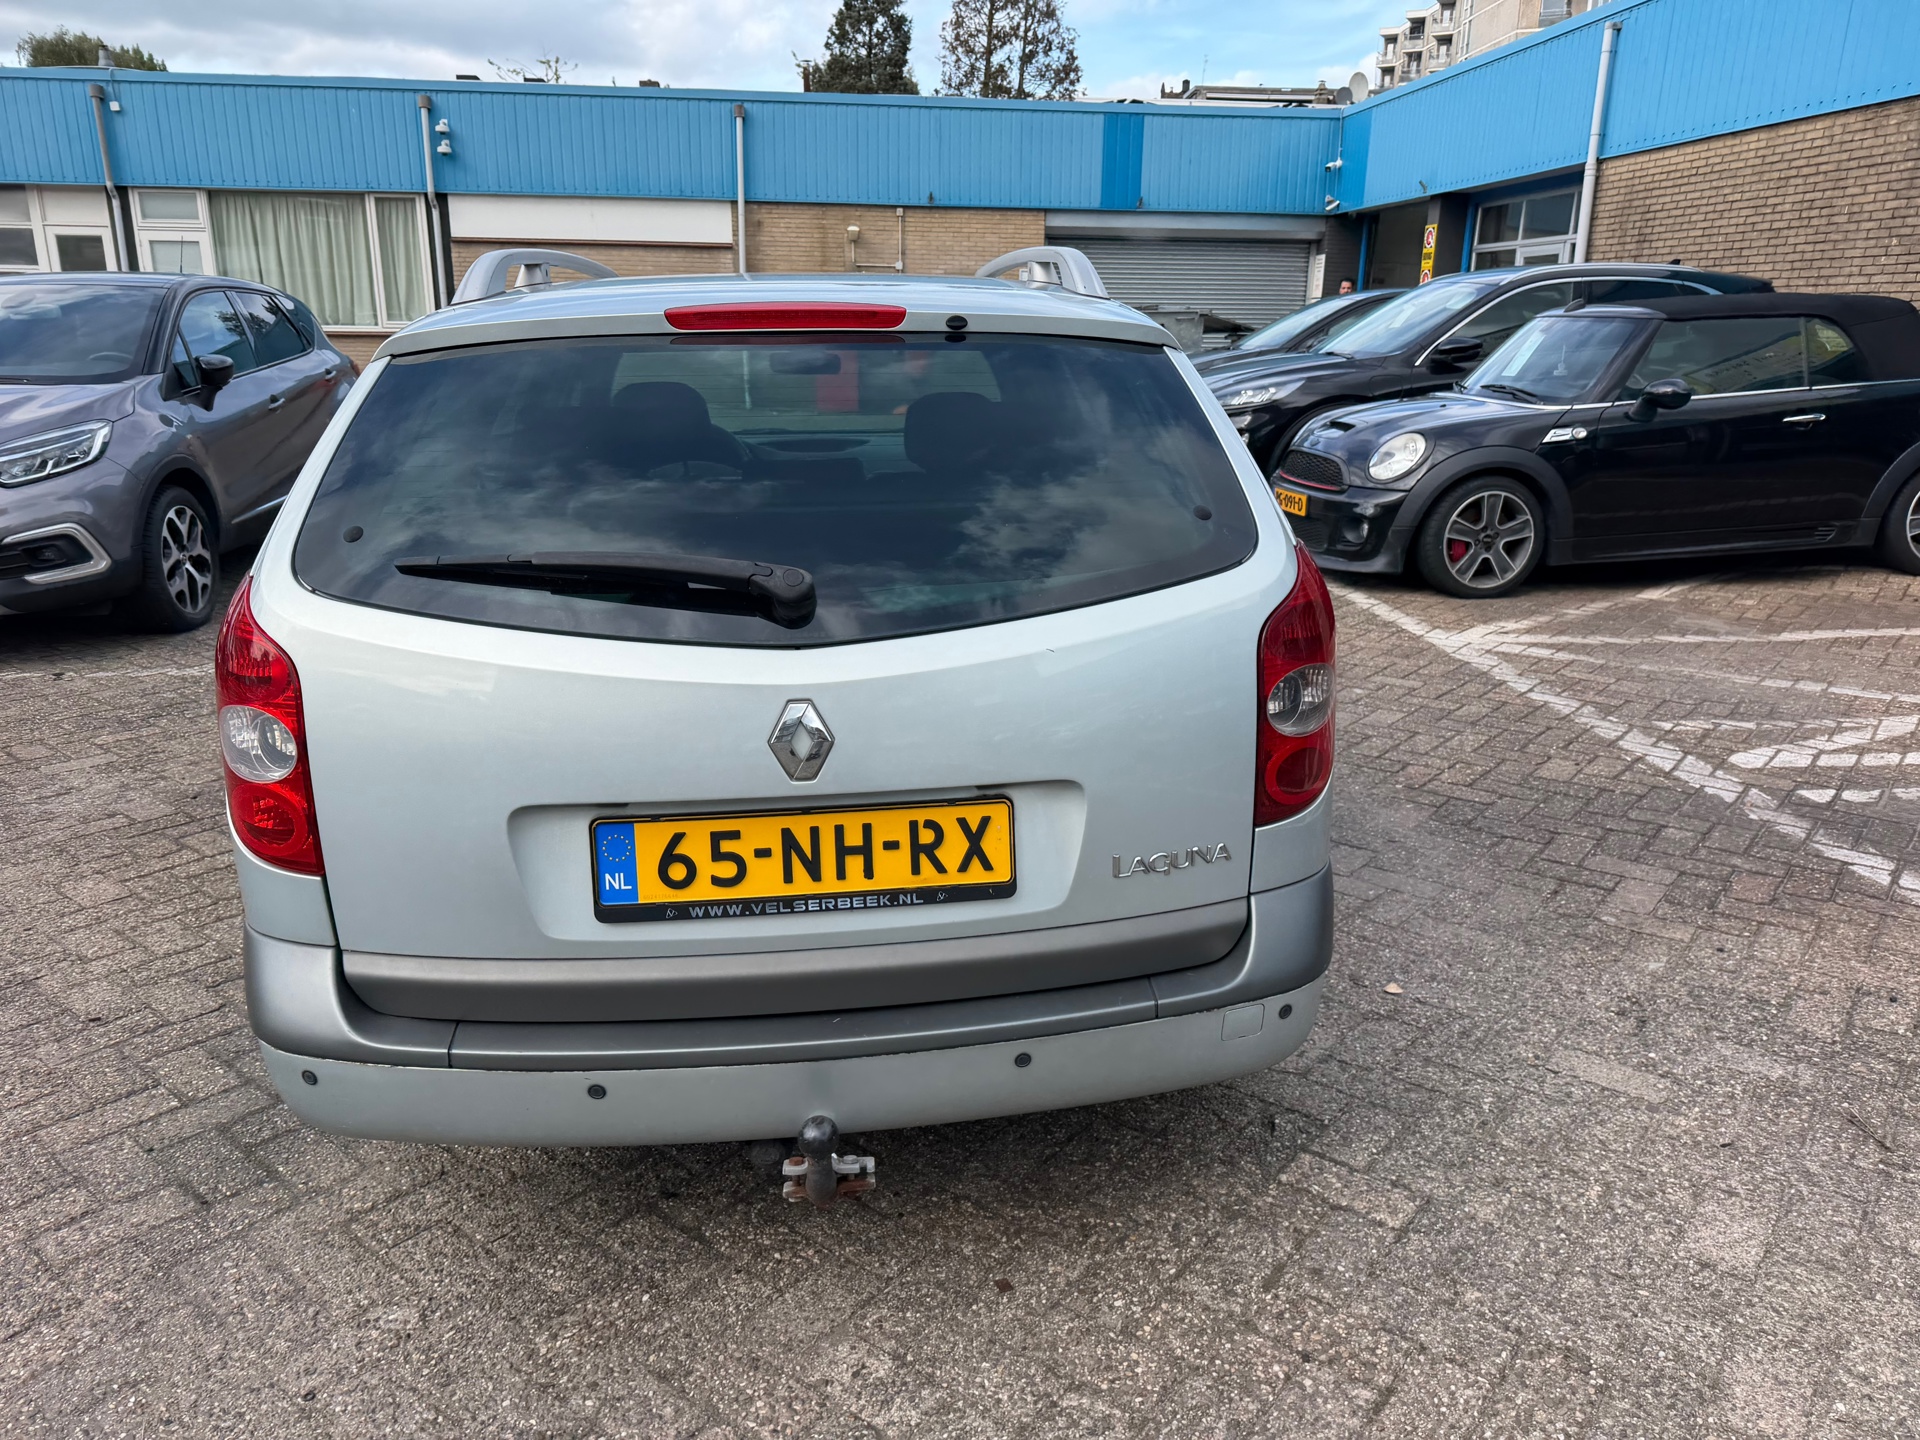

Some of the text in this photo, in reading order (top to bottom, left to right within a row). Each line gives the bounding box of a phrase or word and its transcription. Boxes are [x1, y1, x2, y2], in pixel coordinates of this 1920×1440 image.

[657, 815, 994, 890] 65-NH-RX
[1111, 842, 1232, 878] LAGUNA
[604, 872, 633, 891] NL
[688, 893, 924, 918] WWW.VELSERBEEK.NL
